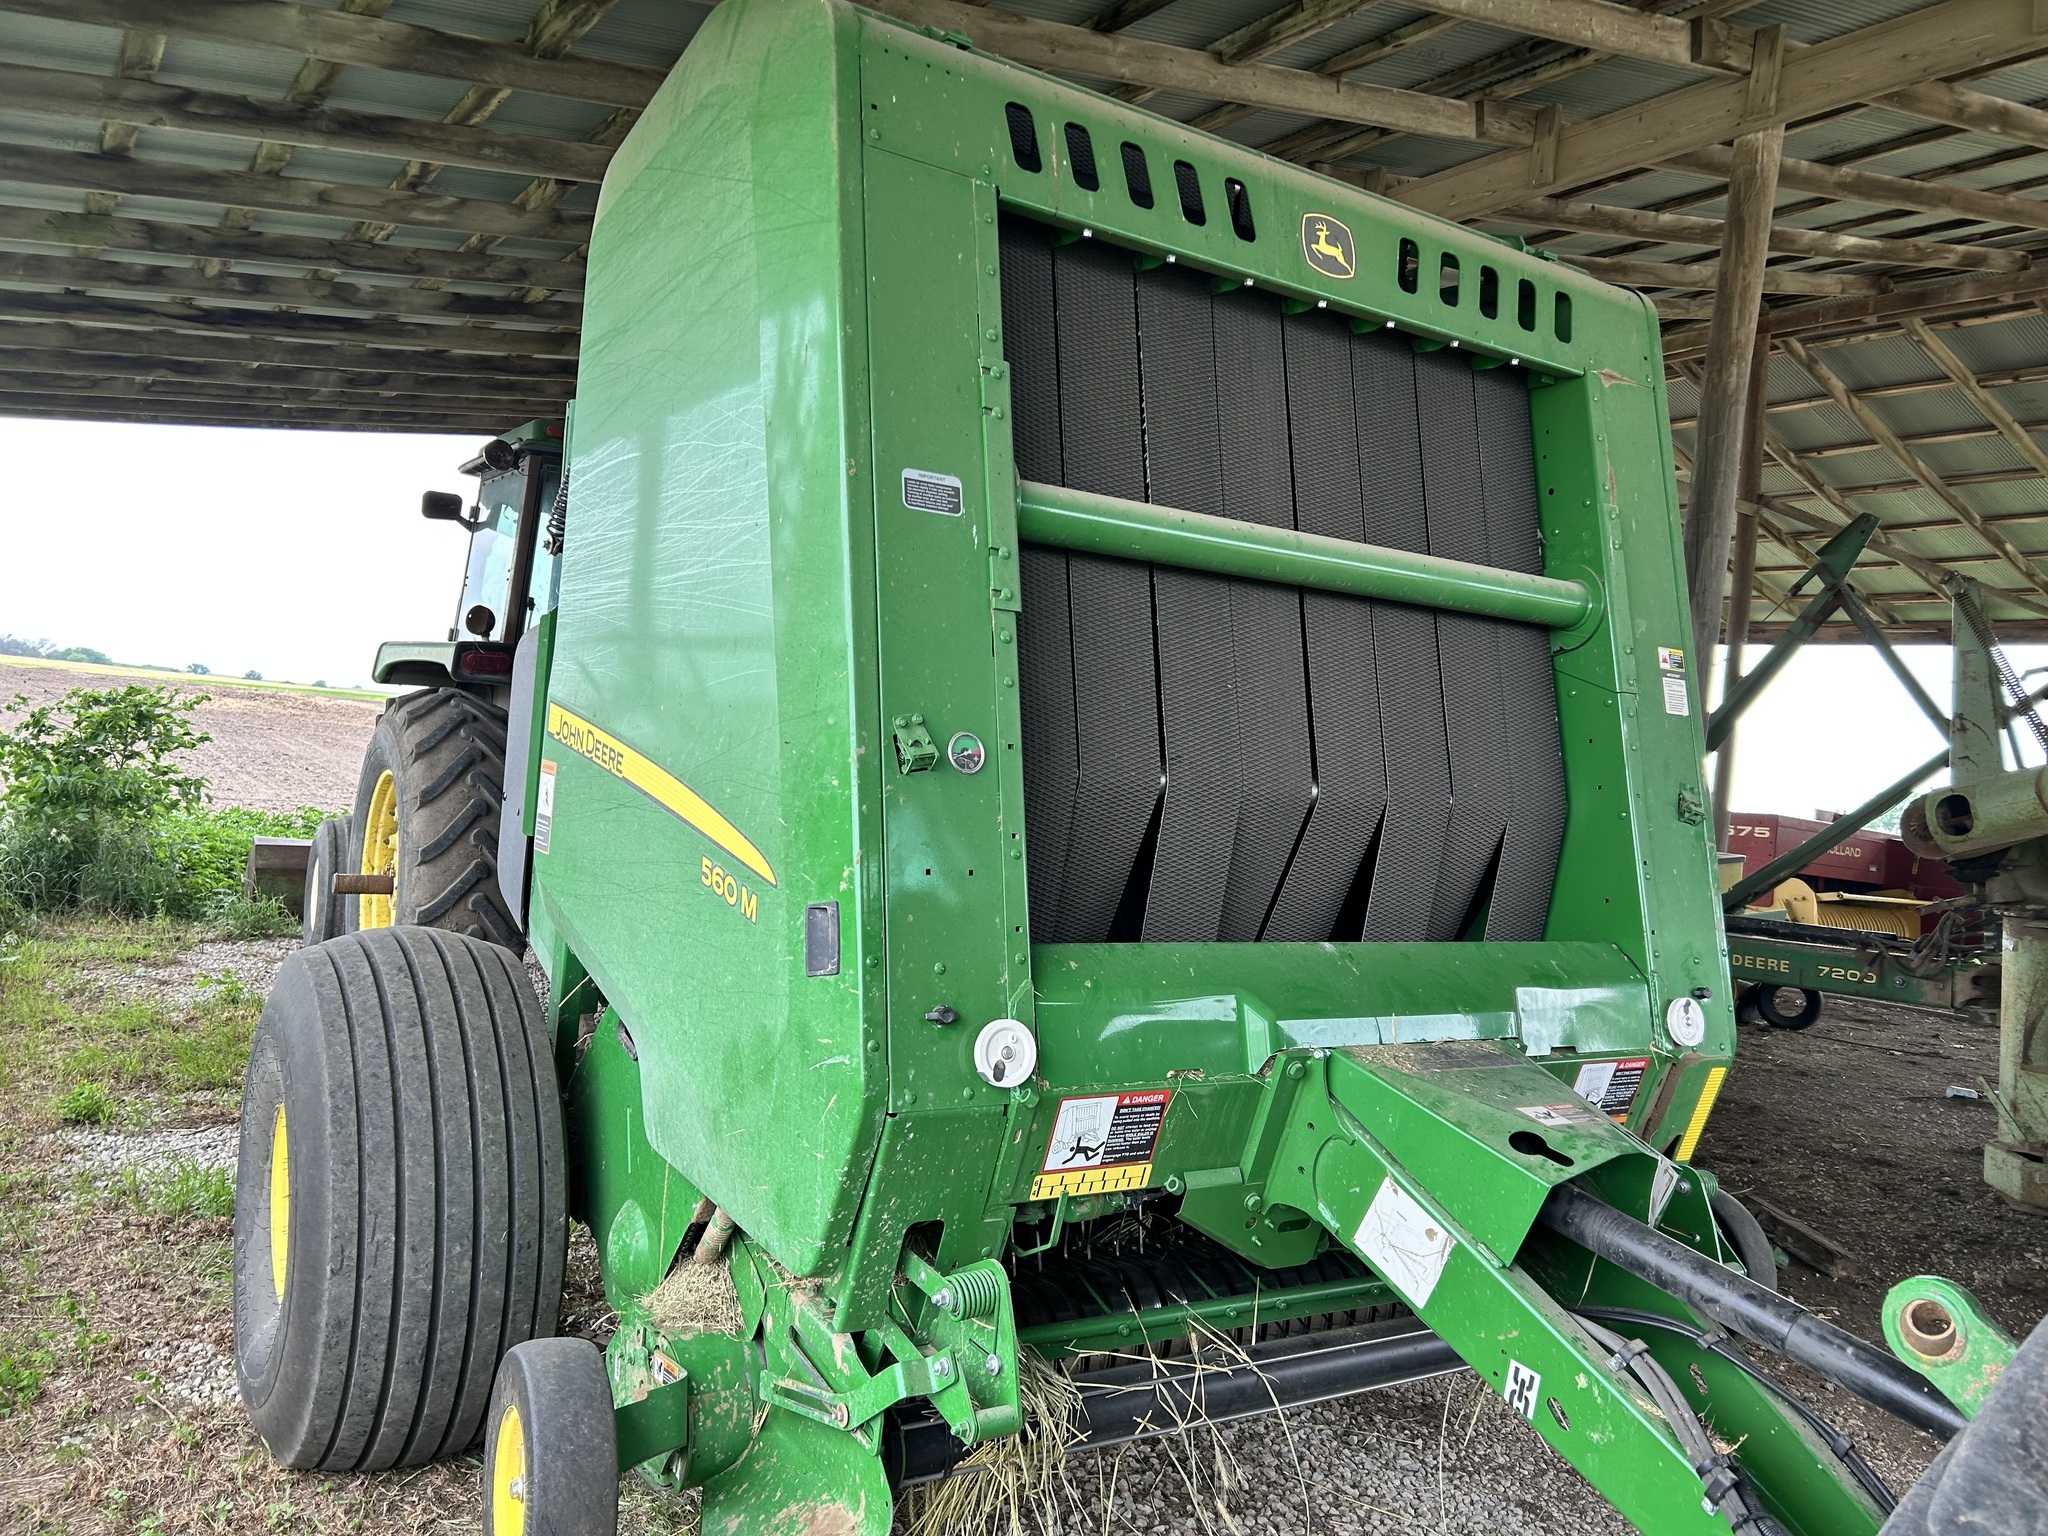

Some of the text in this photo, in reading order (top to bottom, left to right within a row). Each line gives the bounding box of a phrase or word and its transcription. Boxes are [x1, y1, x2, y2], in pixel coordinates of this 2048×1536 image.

[918, 473, 946, 482] IMPORTANT
[556, 714, 624, 775] JOHN DEERE
[1827, 845, 1861, 858] OLLAND
[701, 853, 758, 926] 560 M
[1732, 953, 1877, 984] DEERE 7200
[1131, 1094, 1164, 1103] DANGER
